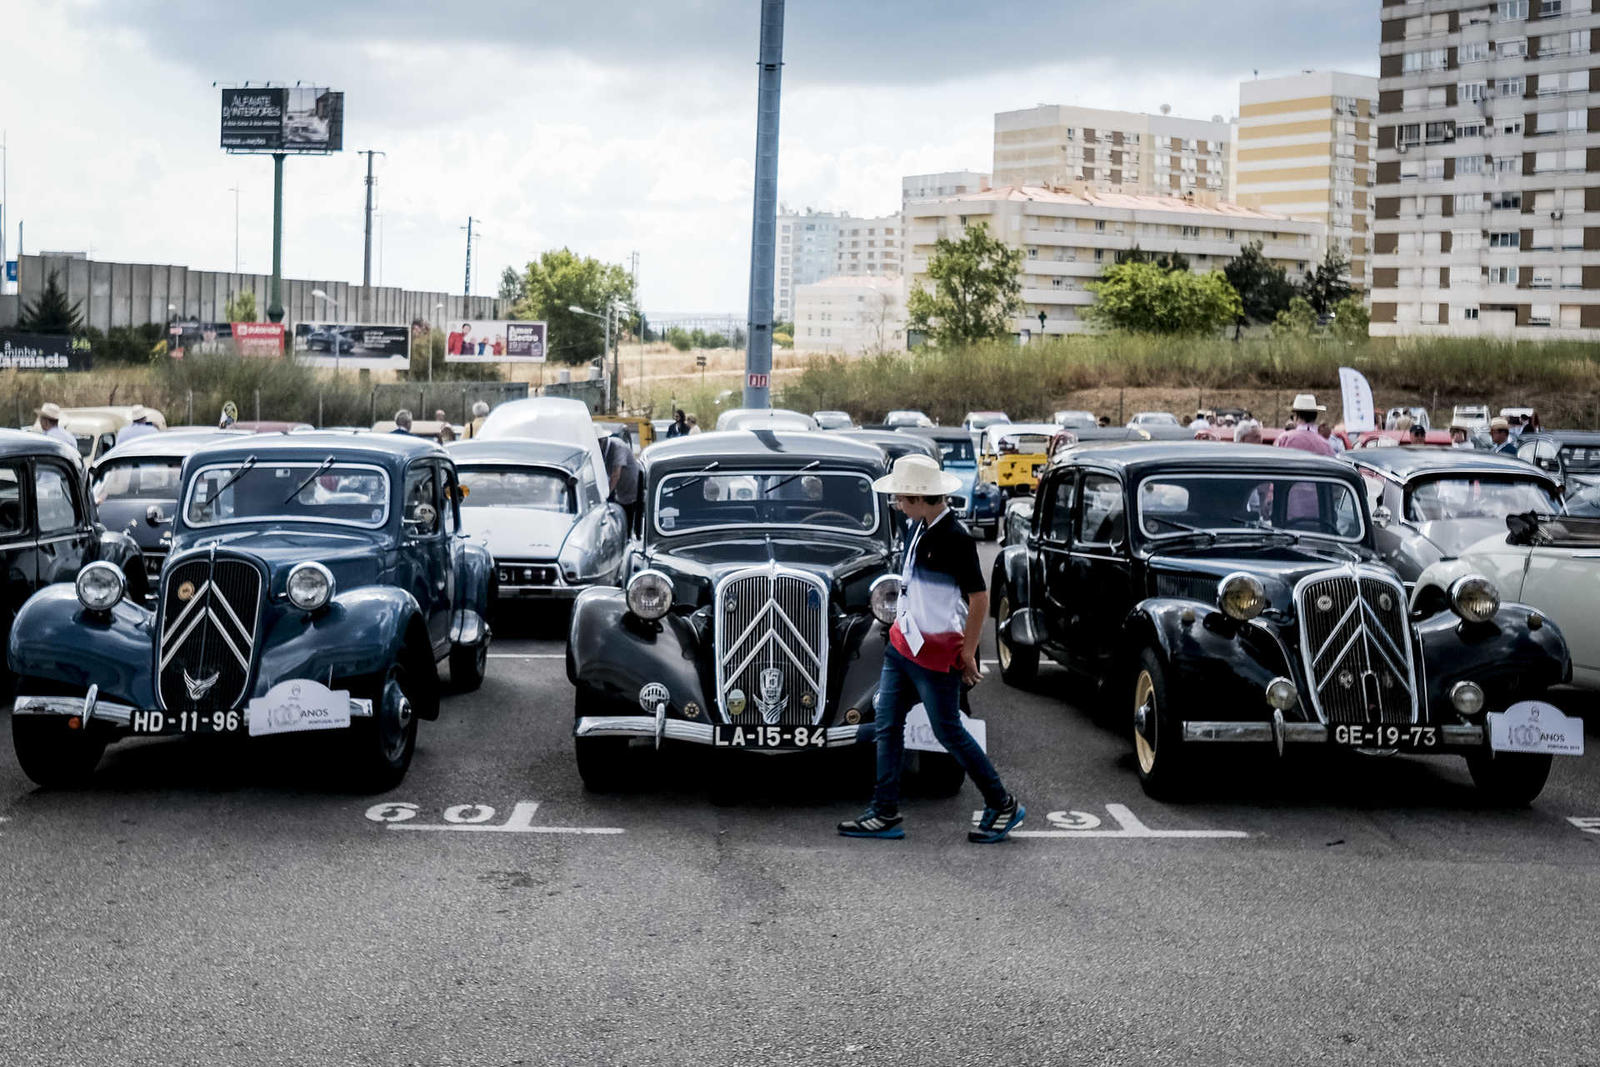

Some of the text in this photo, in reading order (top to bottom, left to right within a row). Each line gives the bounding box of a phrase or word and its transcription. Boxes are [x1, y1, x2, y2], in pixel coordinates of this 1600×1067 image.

[133, 711, 239, 732] HD-11-96
[300, 708, 329, 719] ANOS
[715, 725, 825, 747] LA-15-84
[1335, 724, 1437, 747] GE-19-73
